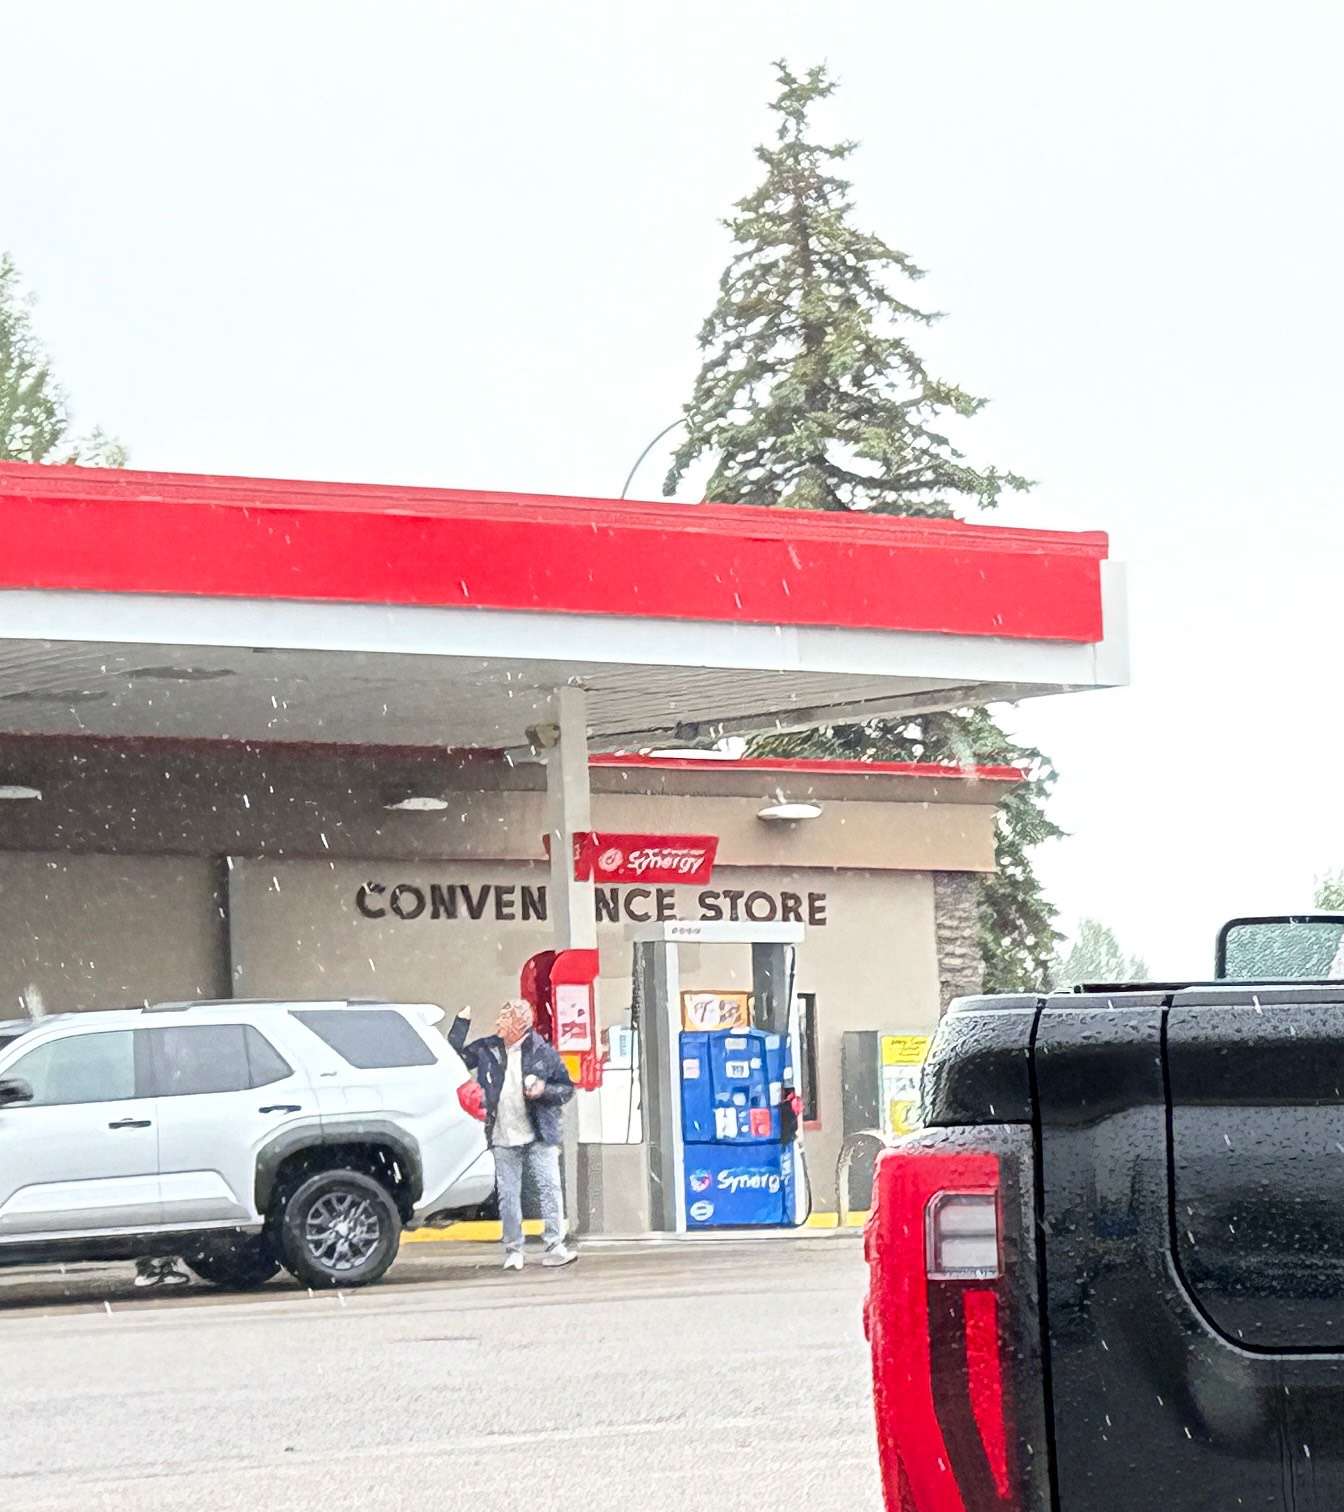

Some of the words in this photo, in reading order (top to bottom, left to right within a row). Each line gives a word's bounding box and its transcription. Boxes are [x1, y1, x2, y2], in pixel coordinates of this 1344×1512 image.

[627, 848, 705, 875] Synergy
[356, 881, 676, 922] CONVENNCE
[698, 890, 827, 926] STORE
